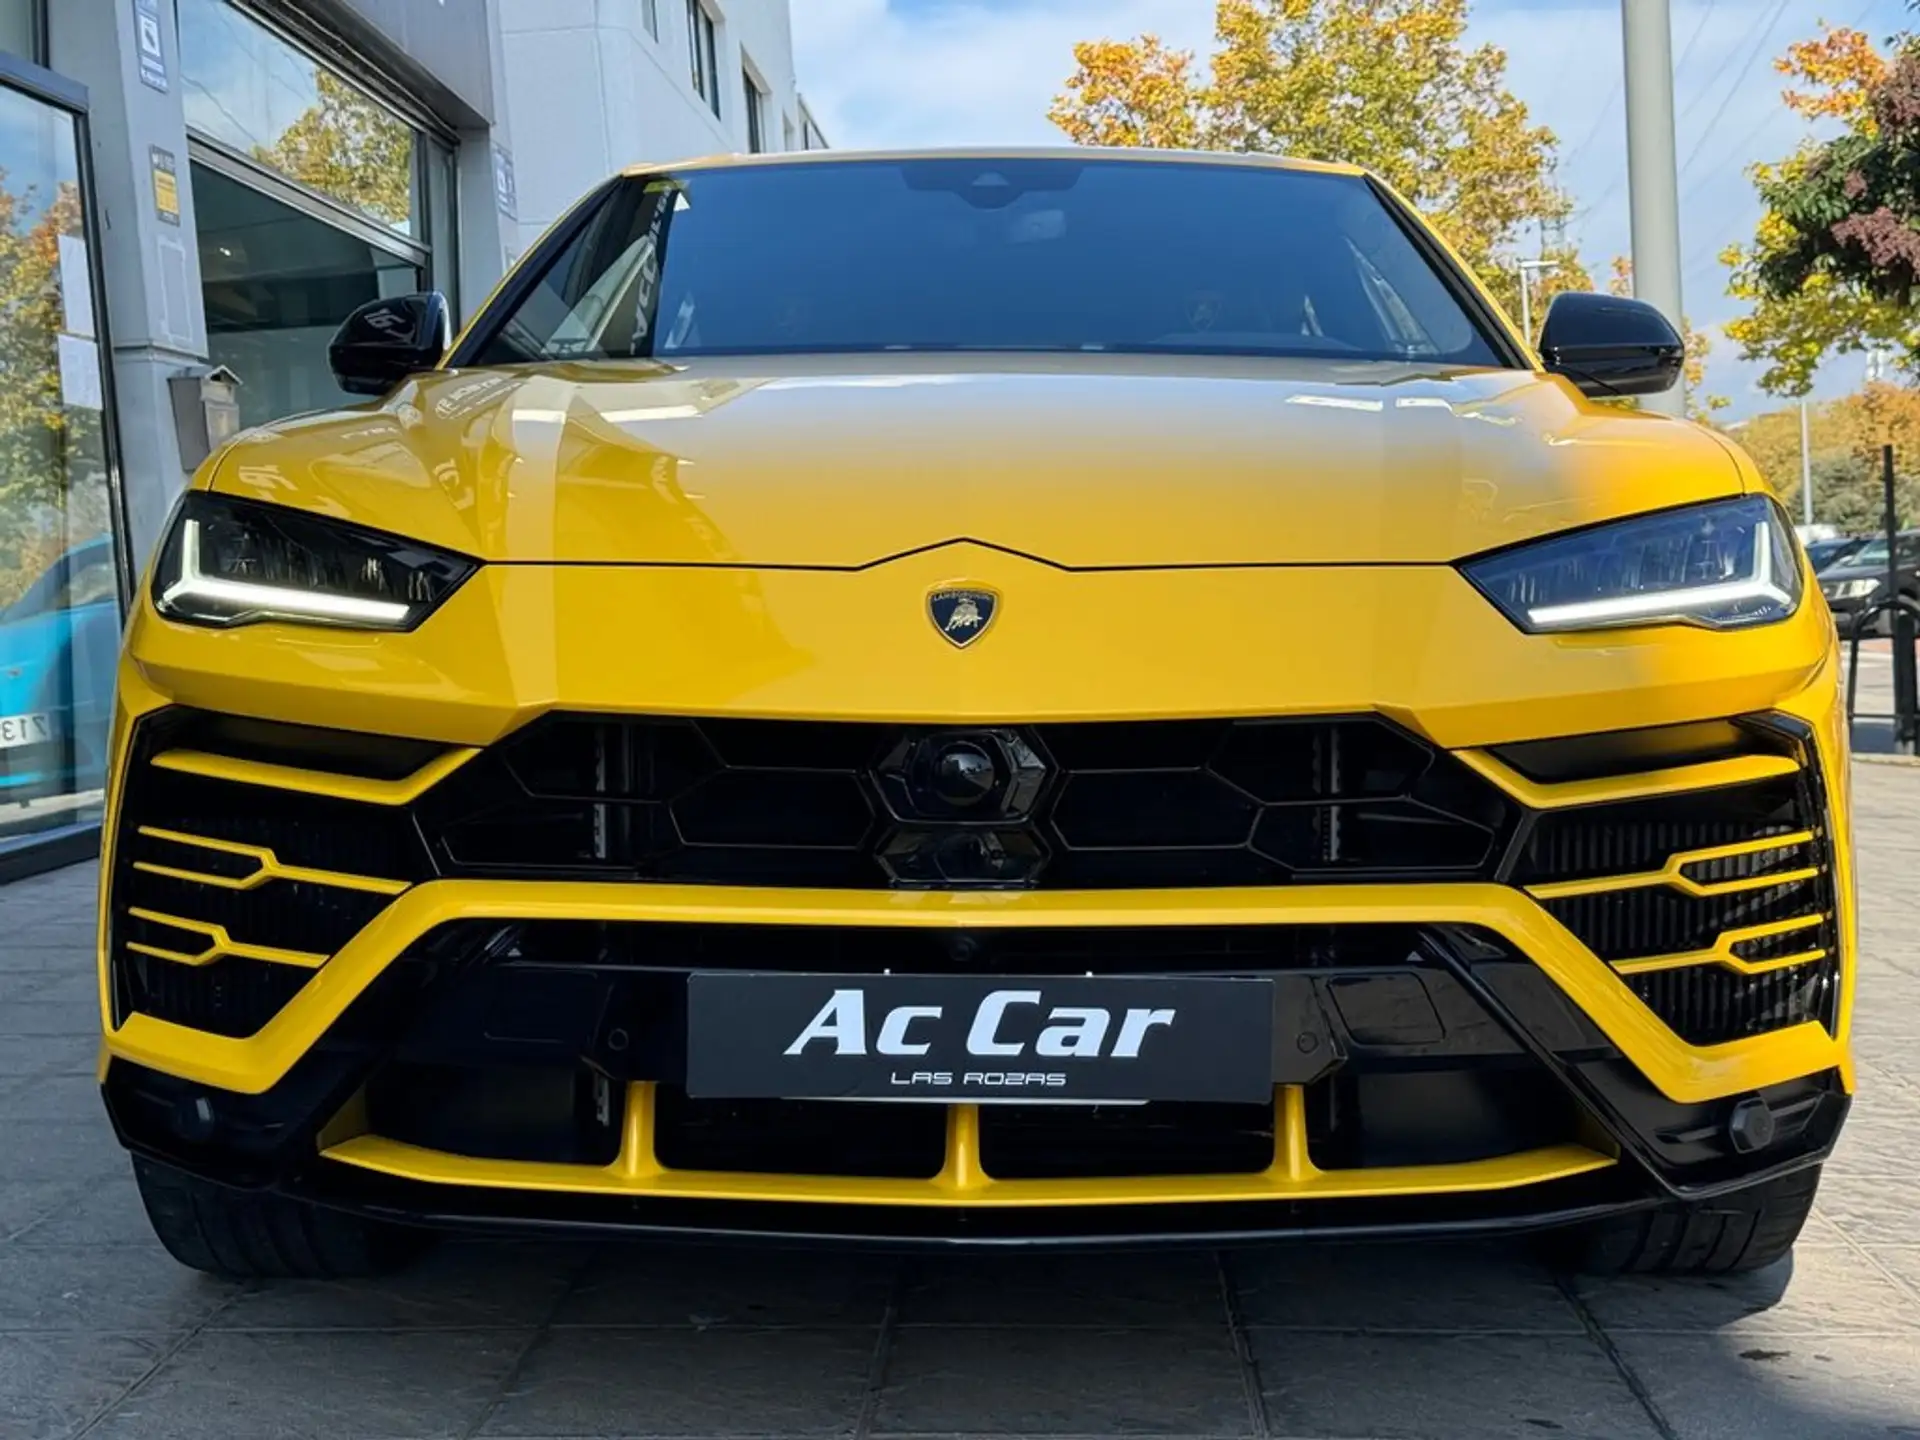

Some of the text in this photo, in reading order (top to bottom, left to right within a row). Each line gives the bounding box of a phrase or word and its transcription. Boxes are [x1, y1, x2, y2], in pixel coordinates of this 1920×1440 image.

[783, 989, 1176, 1058] Ac Car
[890, 1071, 1067, 1086] LAS ROZAS
